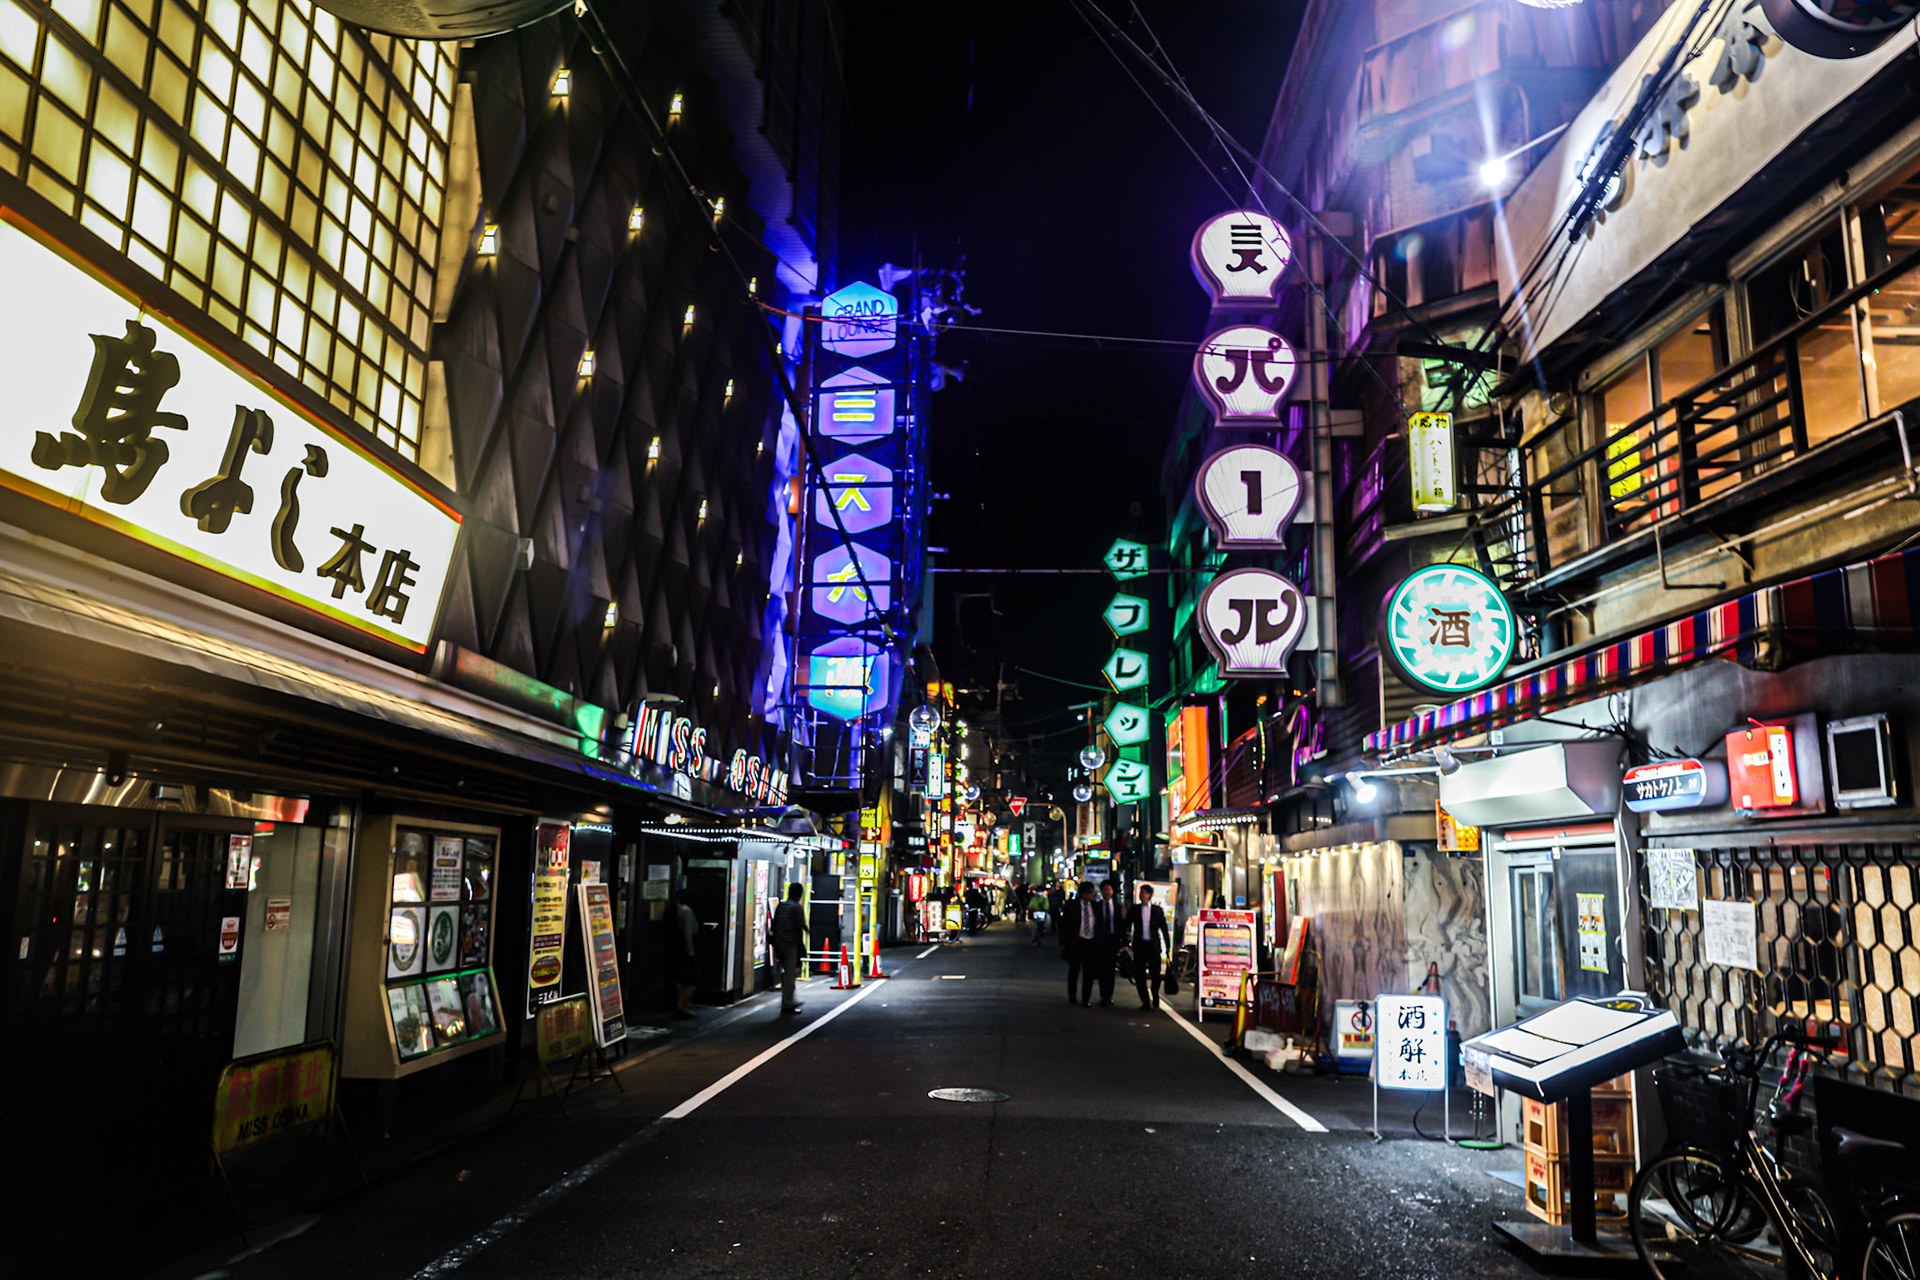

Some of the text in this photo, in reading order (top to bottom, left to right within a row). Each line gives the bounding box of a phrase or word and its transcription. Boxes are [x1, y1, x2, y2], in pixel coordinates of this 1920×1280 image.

[834, 299, 885, 318] GRAND
[1428, 607, 1471, 649] 酒
[632, 700, 706, 778] MISS
[1397, 1005, 1427, 1064] 酒解
[237, 1116, 268, 1142] MISS
